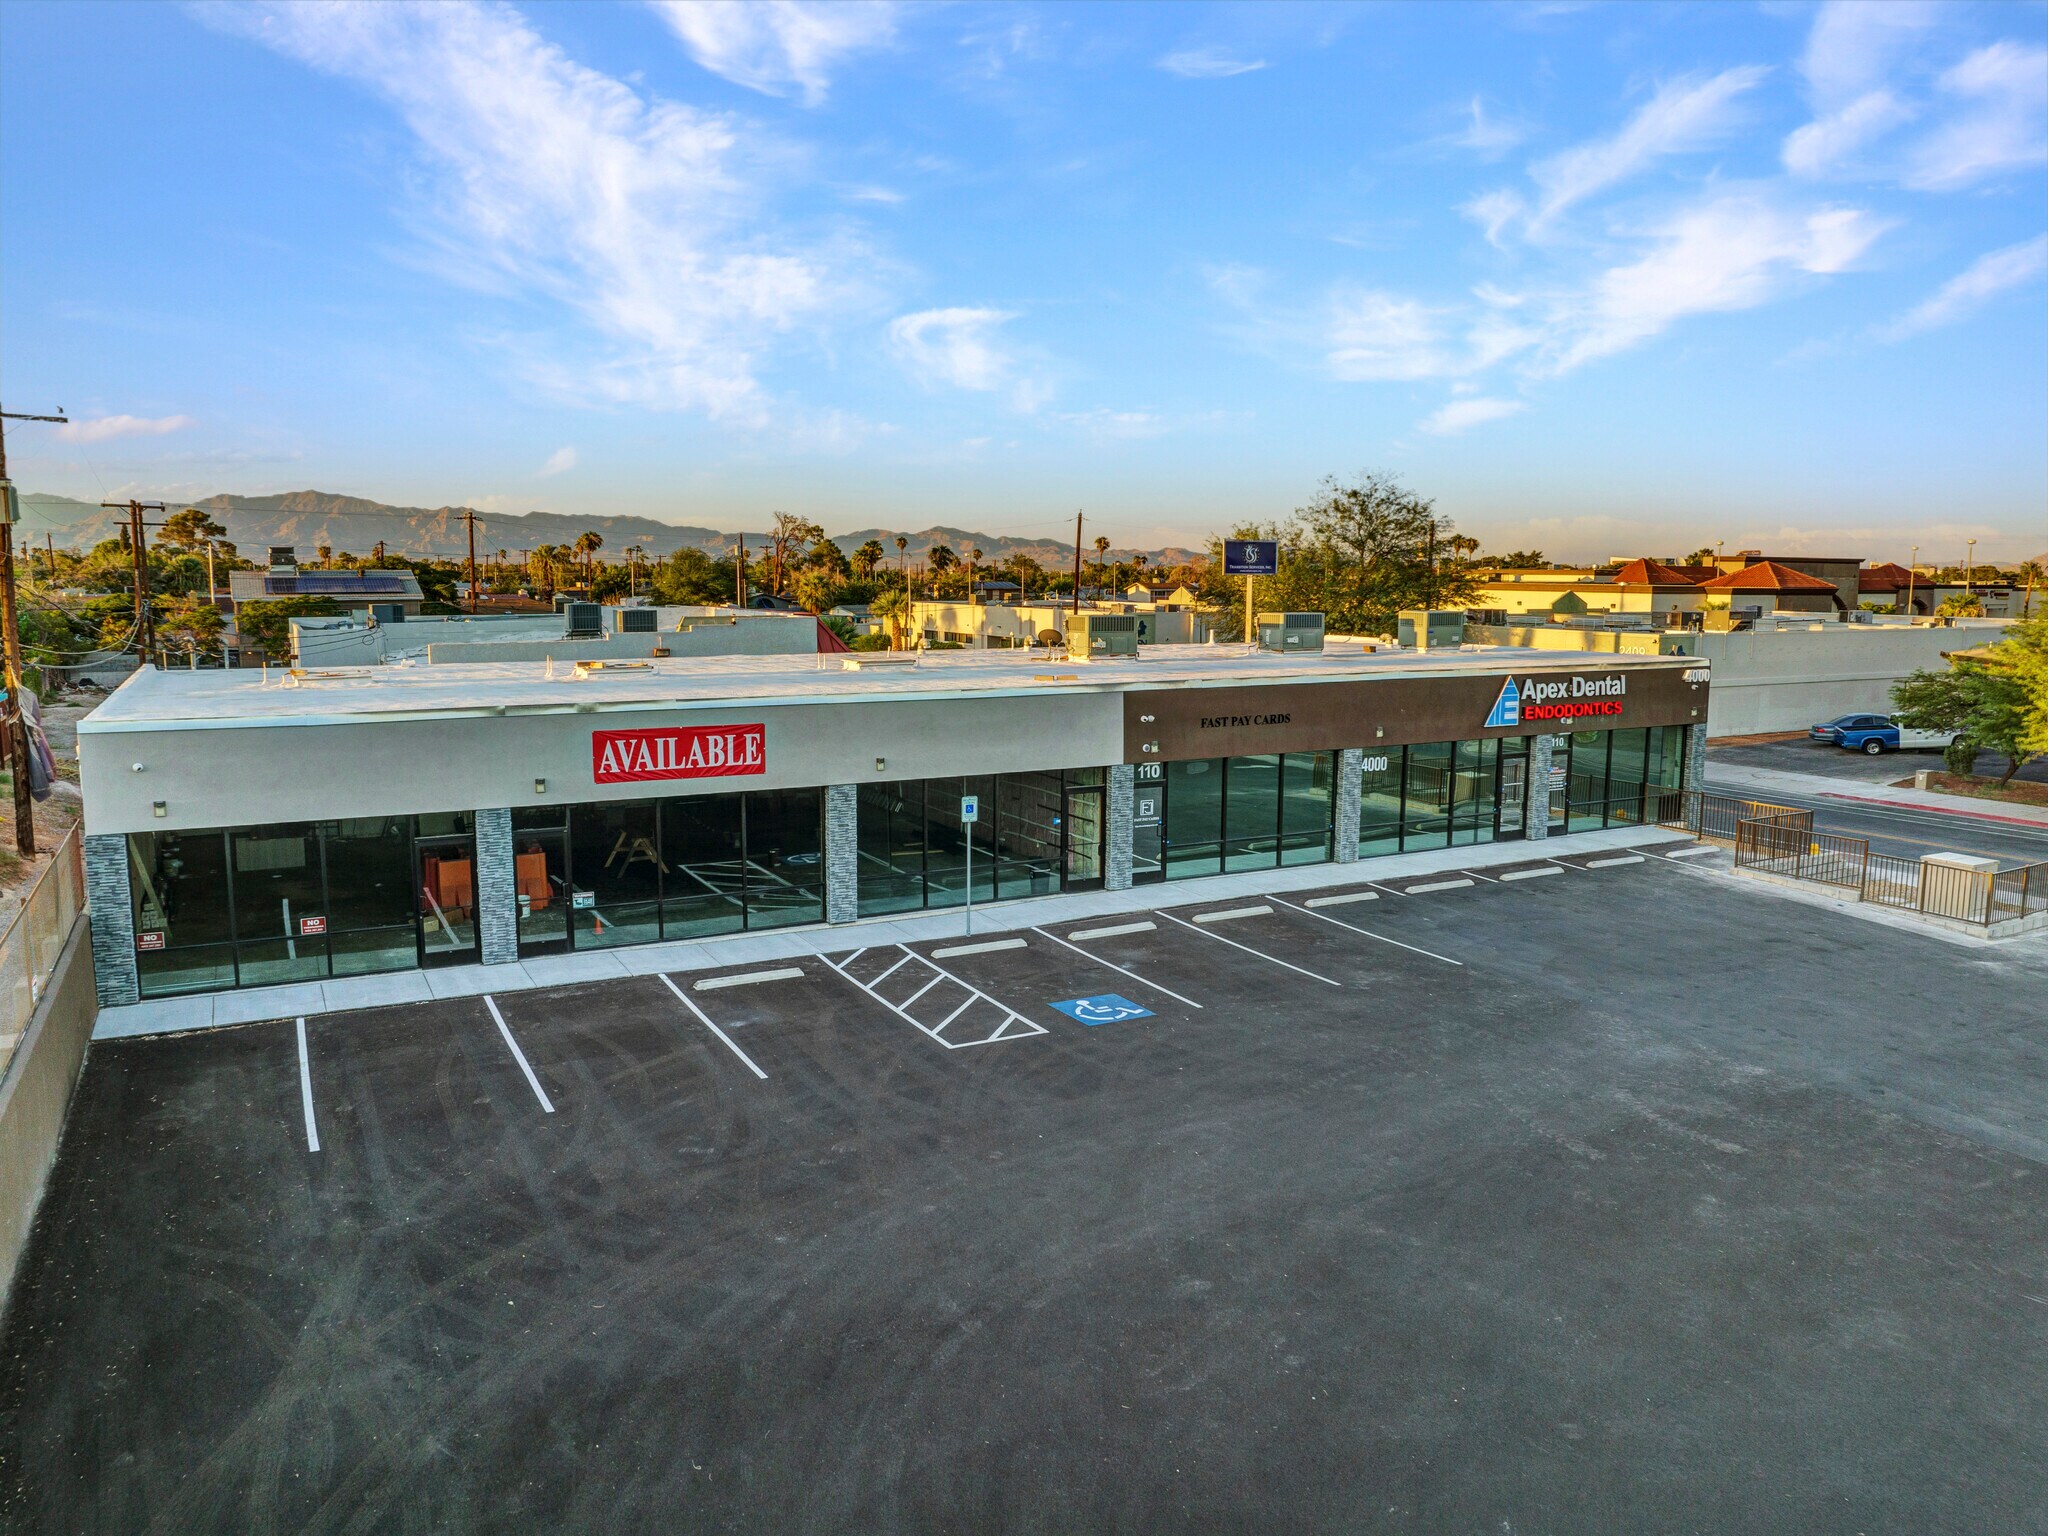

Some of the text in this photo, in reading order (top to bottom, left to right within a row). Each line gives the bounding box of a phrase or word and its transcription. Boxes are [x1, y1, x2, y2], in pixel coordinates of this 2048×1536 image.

[1682, 669, 1710, 682] 4000
[1521, 674, 1626, 704] Apex Dental
[1523, 701, 1623, 720] ENDODONTICS
[1200, 714, 1291, 728] FAST PAY CARDS
[598, 733, 762, 774] AVAILABLE
[1362, 756, 1388, 771] 4000
[1138, 765, 1160, 778] 110
